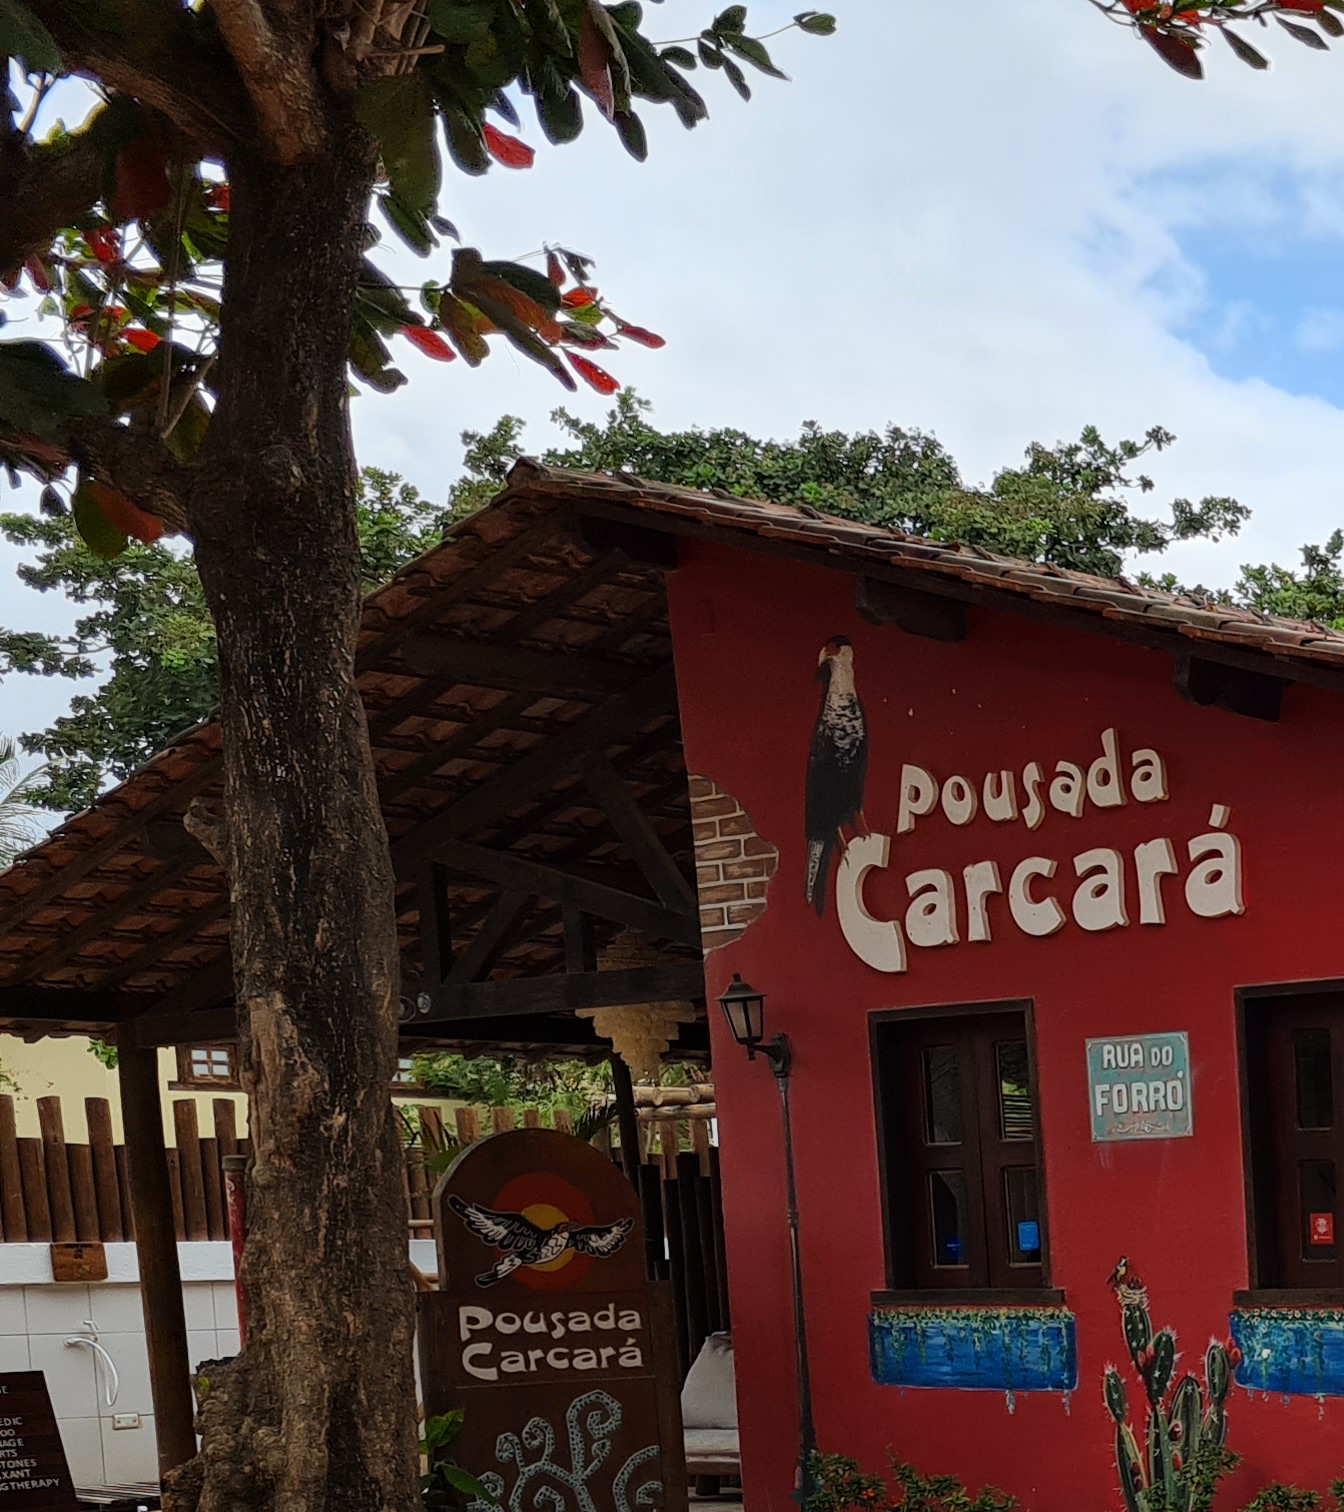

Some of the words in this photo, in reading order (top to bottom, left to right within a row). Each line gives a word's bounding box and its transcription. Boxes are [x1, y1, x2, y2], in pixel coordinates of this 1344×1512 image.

[897, 728, 1169, 833] Pousada
[836, 803, 1246, 973] Carcará
[1103, 1043, 1144, 1069] RUA
[1151, 1046, 1173, 1067] DO
[1095, 1070, 1183, 1116] FORRÓ
[459, 1303, 642, 1342] Pousada
[462, 1338, 644, 1381] Carcará
[9, 1478, 60, 1490] THERAPY
